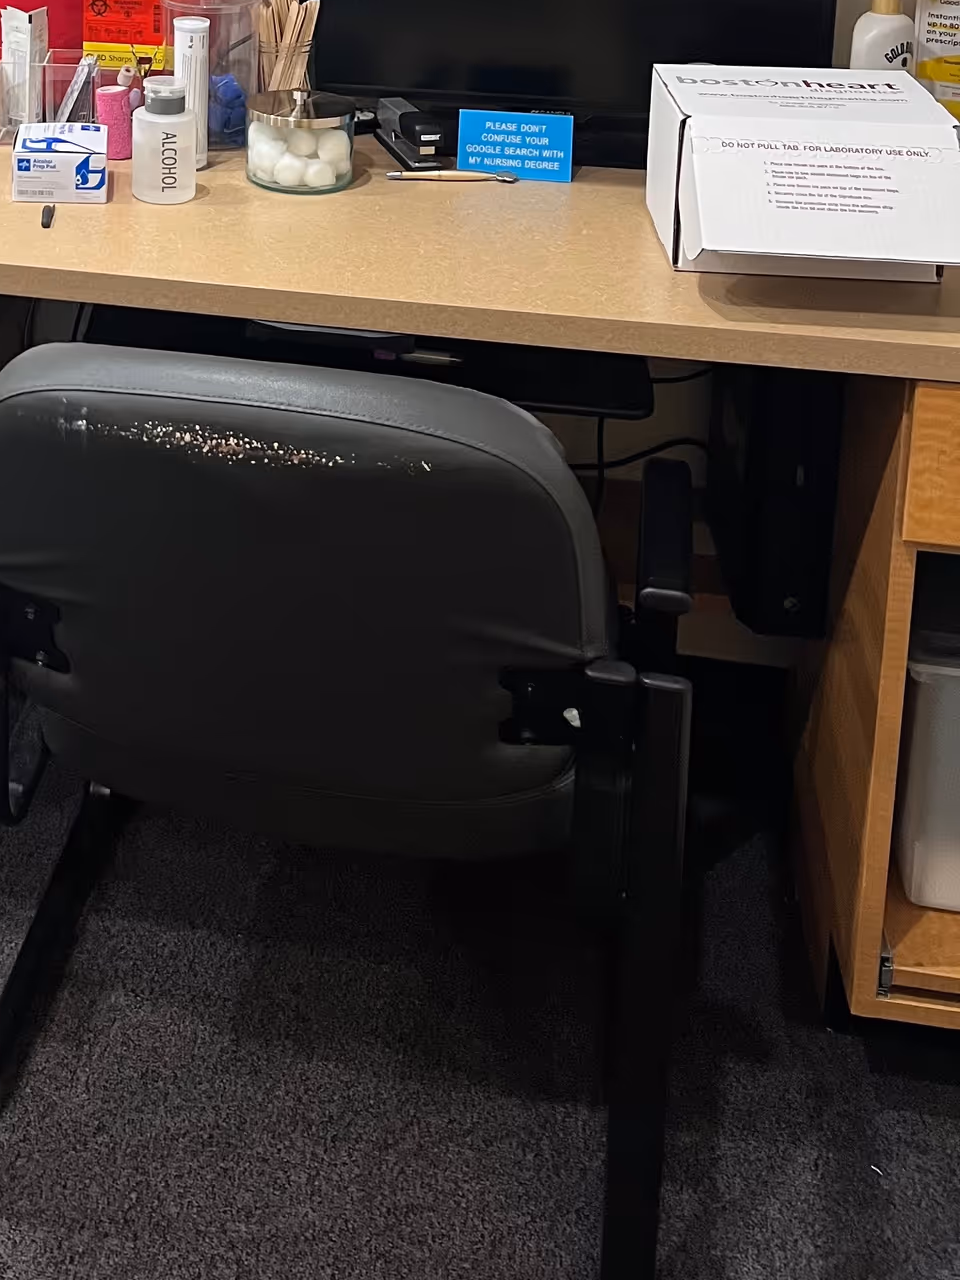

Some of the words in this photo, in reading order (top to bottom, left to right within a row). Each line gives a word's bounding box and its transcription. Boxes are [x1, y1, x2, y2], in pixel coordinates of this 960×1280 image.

[928, 12, 960, 20] Instantl
[928, 22, 938, 30] up
[884, 42, 905, 63] GOLD
[108, 54, 132, 64] Sharps
[486, 122, 517, 132] PLEASE
[521, 124, 546, 133] DON'T
[482, 133, 522, 144] CONFUSE
[525, 136, 549, 145] YOUR
[466, 144, 501, 154] GOOGLE
[504, 147, 539, 157] SEARCH
[542, 150, 564, 158] WITH
[824, 146, 883, 155] LABORATORY
[906, 150, 931, 158] ONLY.
[162, 132, 177, 193] ALCOHOL
[469, 156, 481, 164] MY
[484, 158, 522, 168] NURSING
[525, 160, 560, 170] DEGREE
